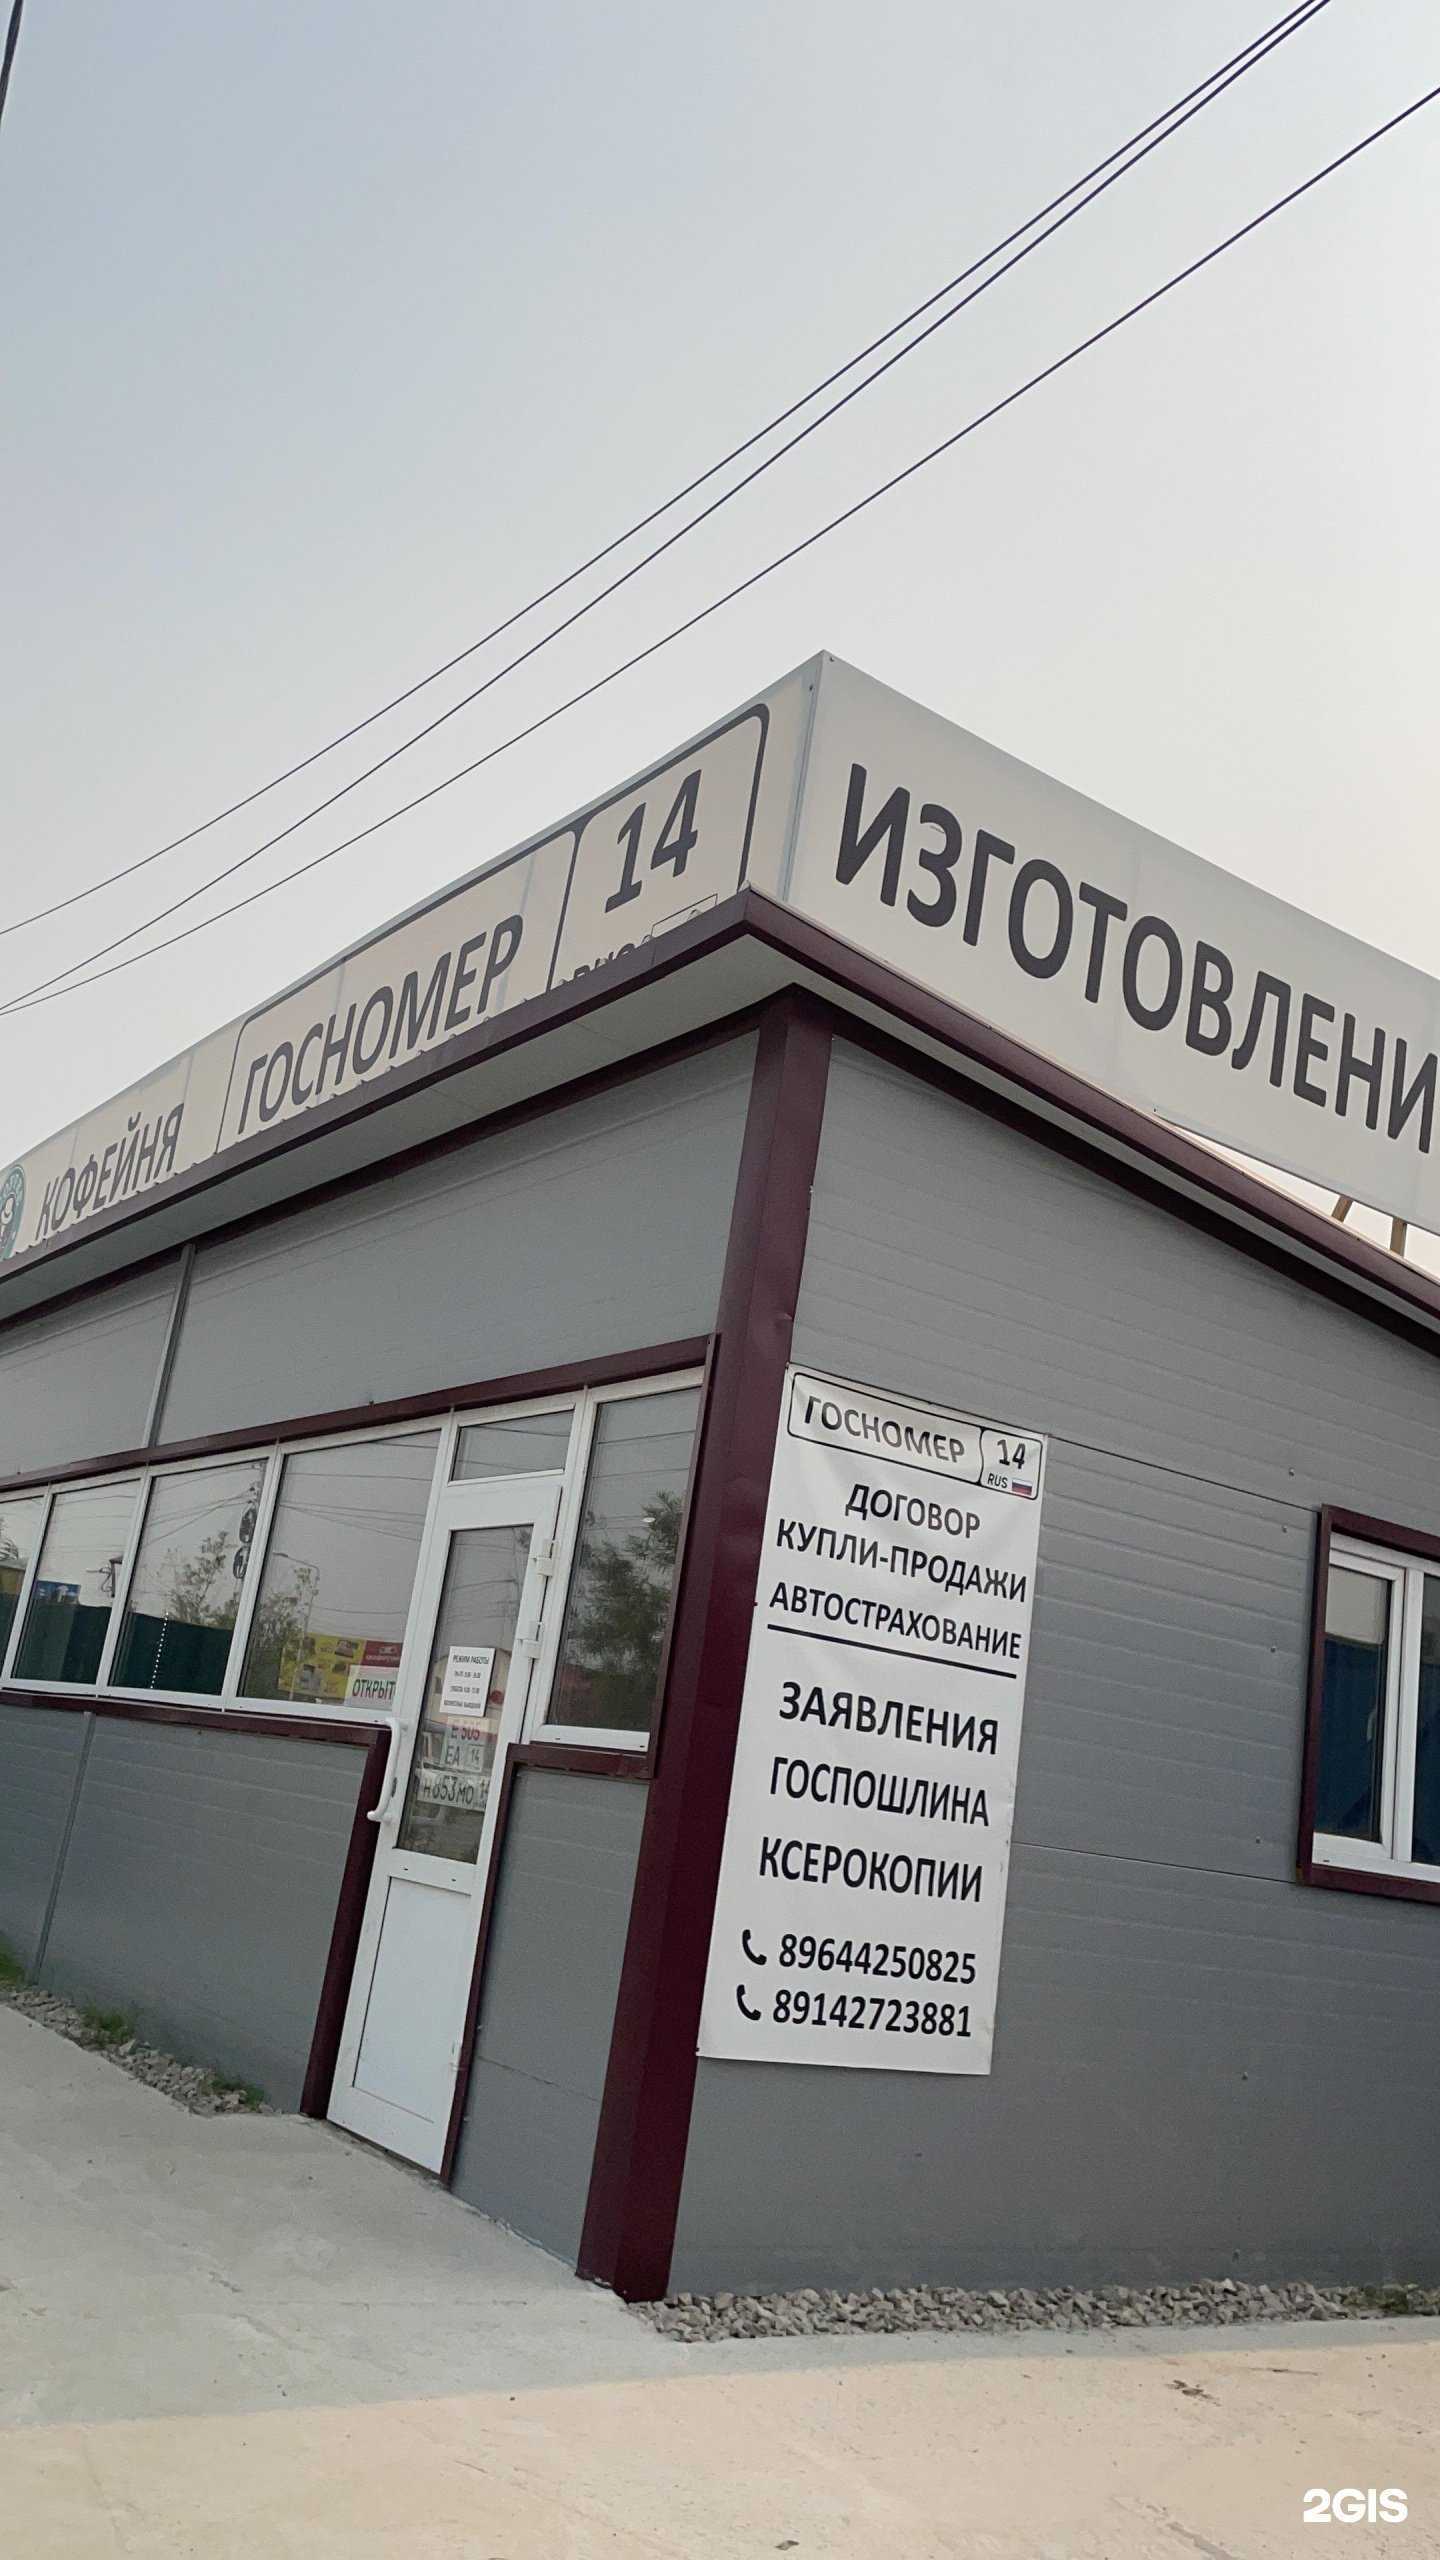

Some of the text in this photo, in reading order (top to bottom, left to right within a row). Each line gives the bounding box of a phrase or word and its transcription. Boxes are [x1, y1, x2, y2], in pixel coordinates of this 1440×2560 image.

[238, 769, 702, 1135] ГОСНОМЕР 14
[835, 763, 1438, 1155] ИЗГОТОВЛЕНИ
[35, 1103, 184, 1241] КОФЕЙНЯ
[804, 1395, 1026, 1469] ГОСНОМЕР 14
[845, 1483, 980, 1539] ДОГОВОР
[987, 1473, 1008, 1489] RUS
[776, 1518, 1027, 1602] КУПЛИ-ПРОДАЖИ
[769, 1582, 1022, 1659] АВТОСТРАХОВАНИЕ
[352, 1678, 397, 1700] ОТКРЫТ
[779, 1681, 999, 1754] ЗАЯВЛЕНИЯ
[769, 1756, 989, 1826] ГОСПОШЛИНА
[759, 1836, 983, 1902] КСЕРОКОПИИ
[778, 1933, 976, 1984] 89644250825
[772, 1989, 972, 2037] 89142723881
